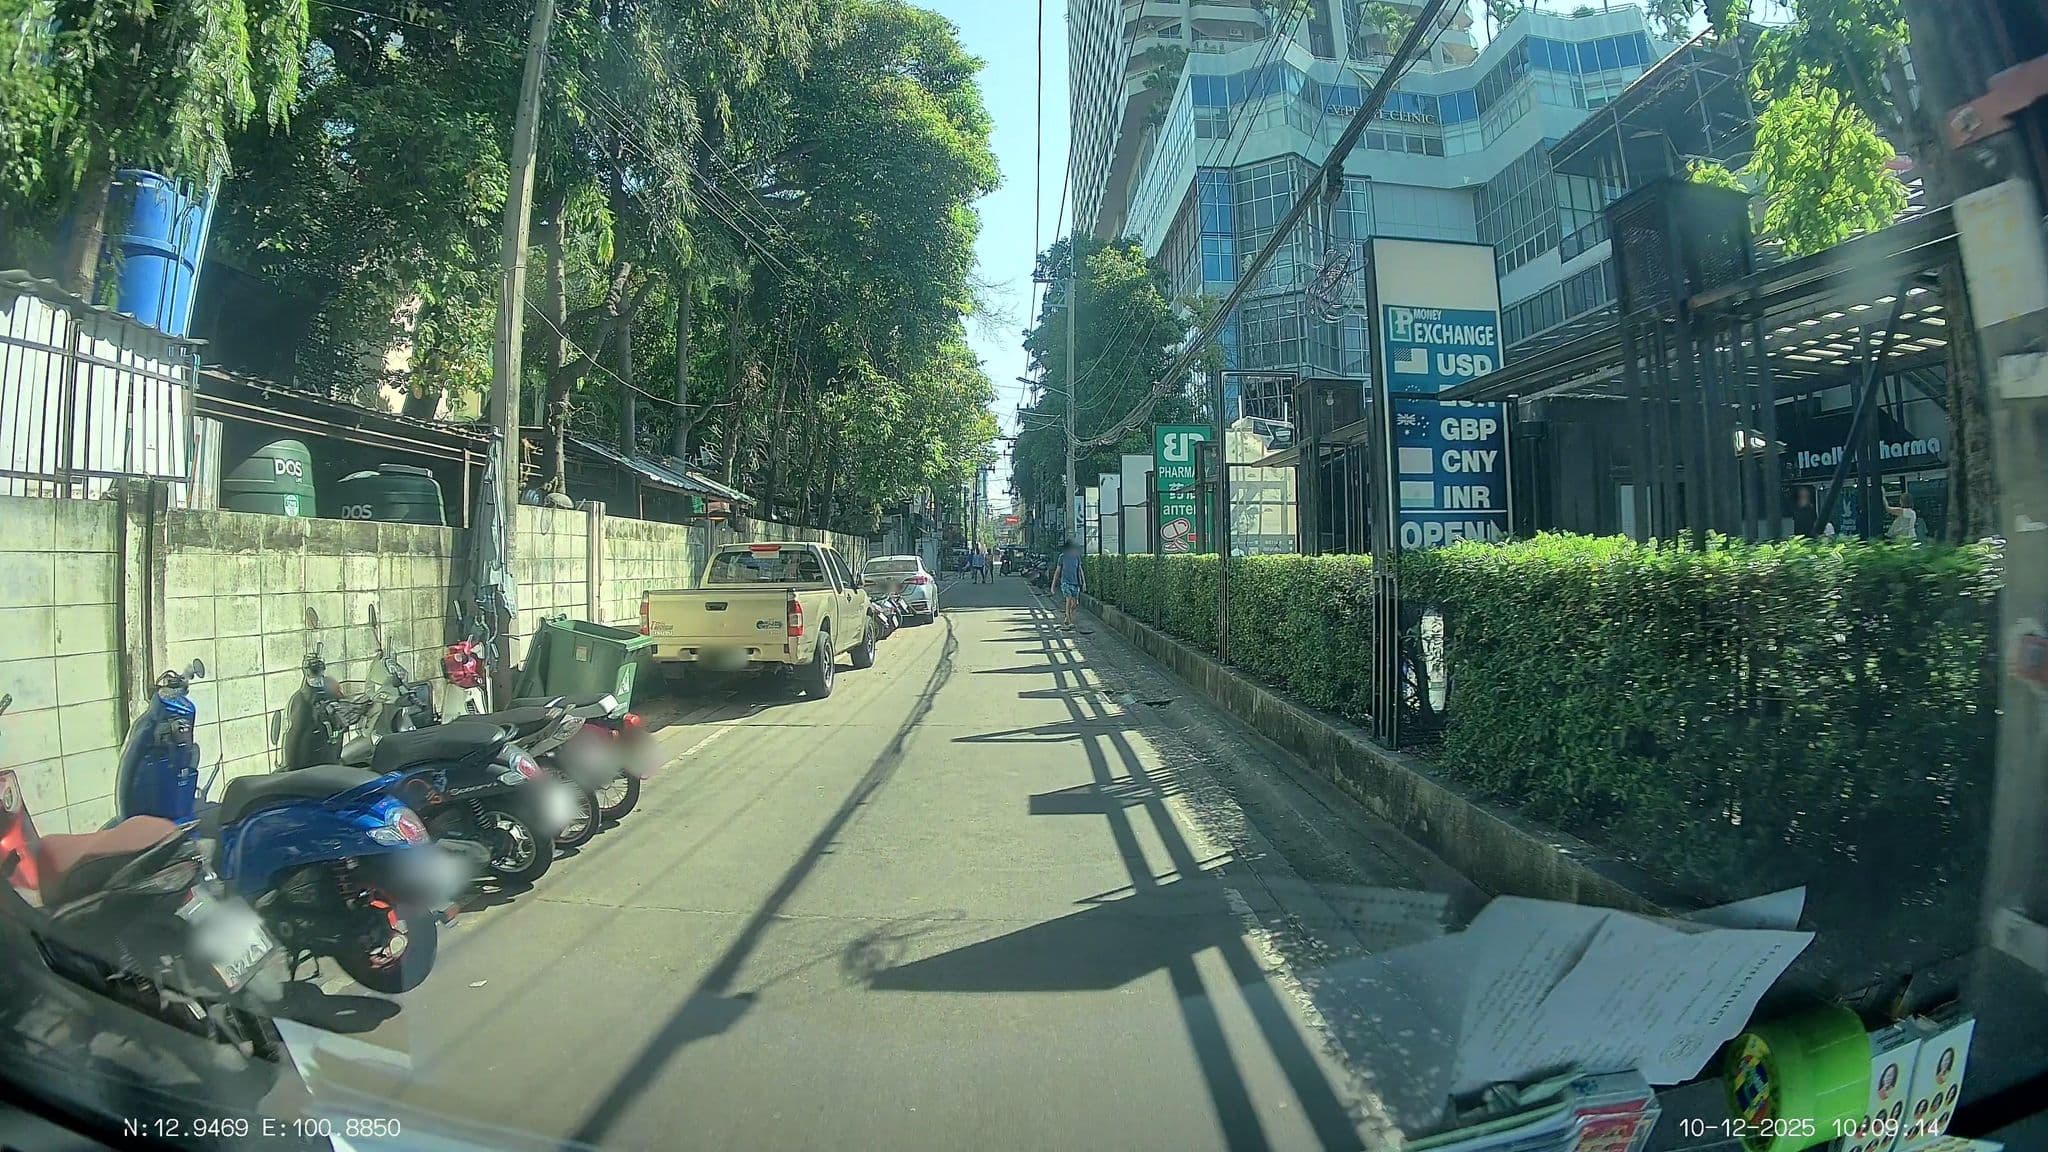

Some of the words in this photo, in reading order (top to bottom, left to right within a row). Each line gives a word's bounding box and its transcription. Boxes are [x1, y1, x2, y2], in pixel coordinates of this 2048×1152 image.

[1413, 308, 1442, 321] MONEY
[1414, 322, 1495, 346] EXCHANGE
[1436, 352, 1493, 377] USD
[1440, 417, 1497, 441] GBP
[274, 458, 303, 478] DOS
[1441, 449, 1498, 473] CNY
[1443, 485, 1491, 509] INR
[341, 504, 373, 520] DOS
